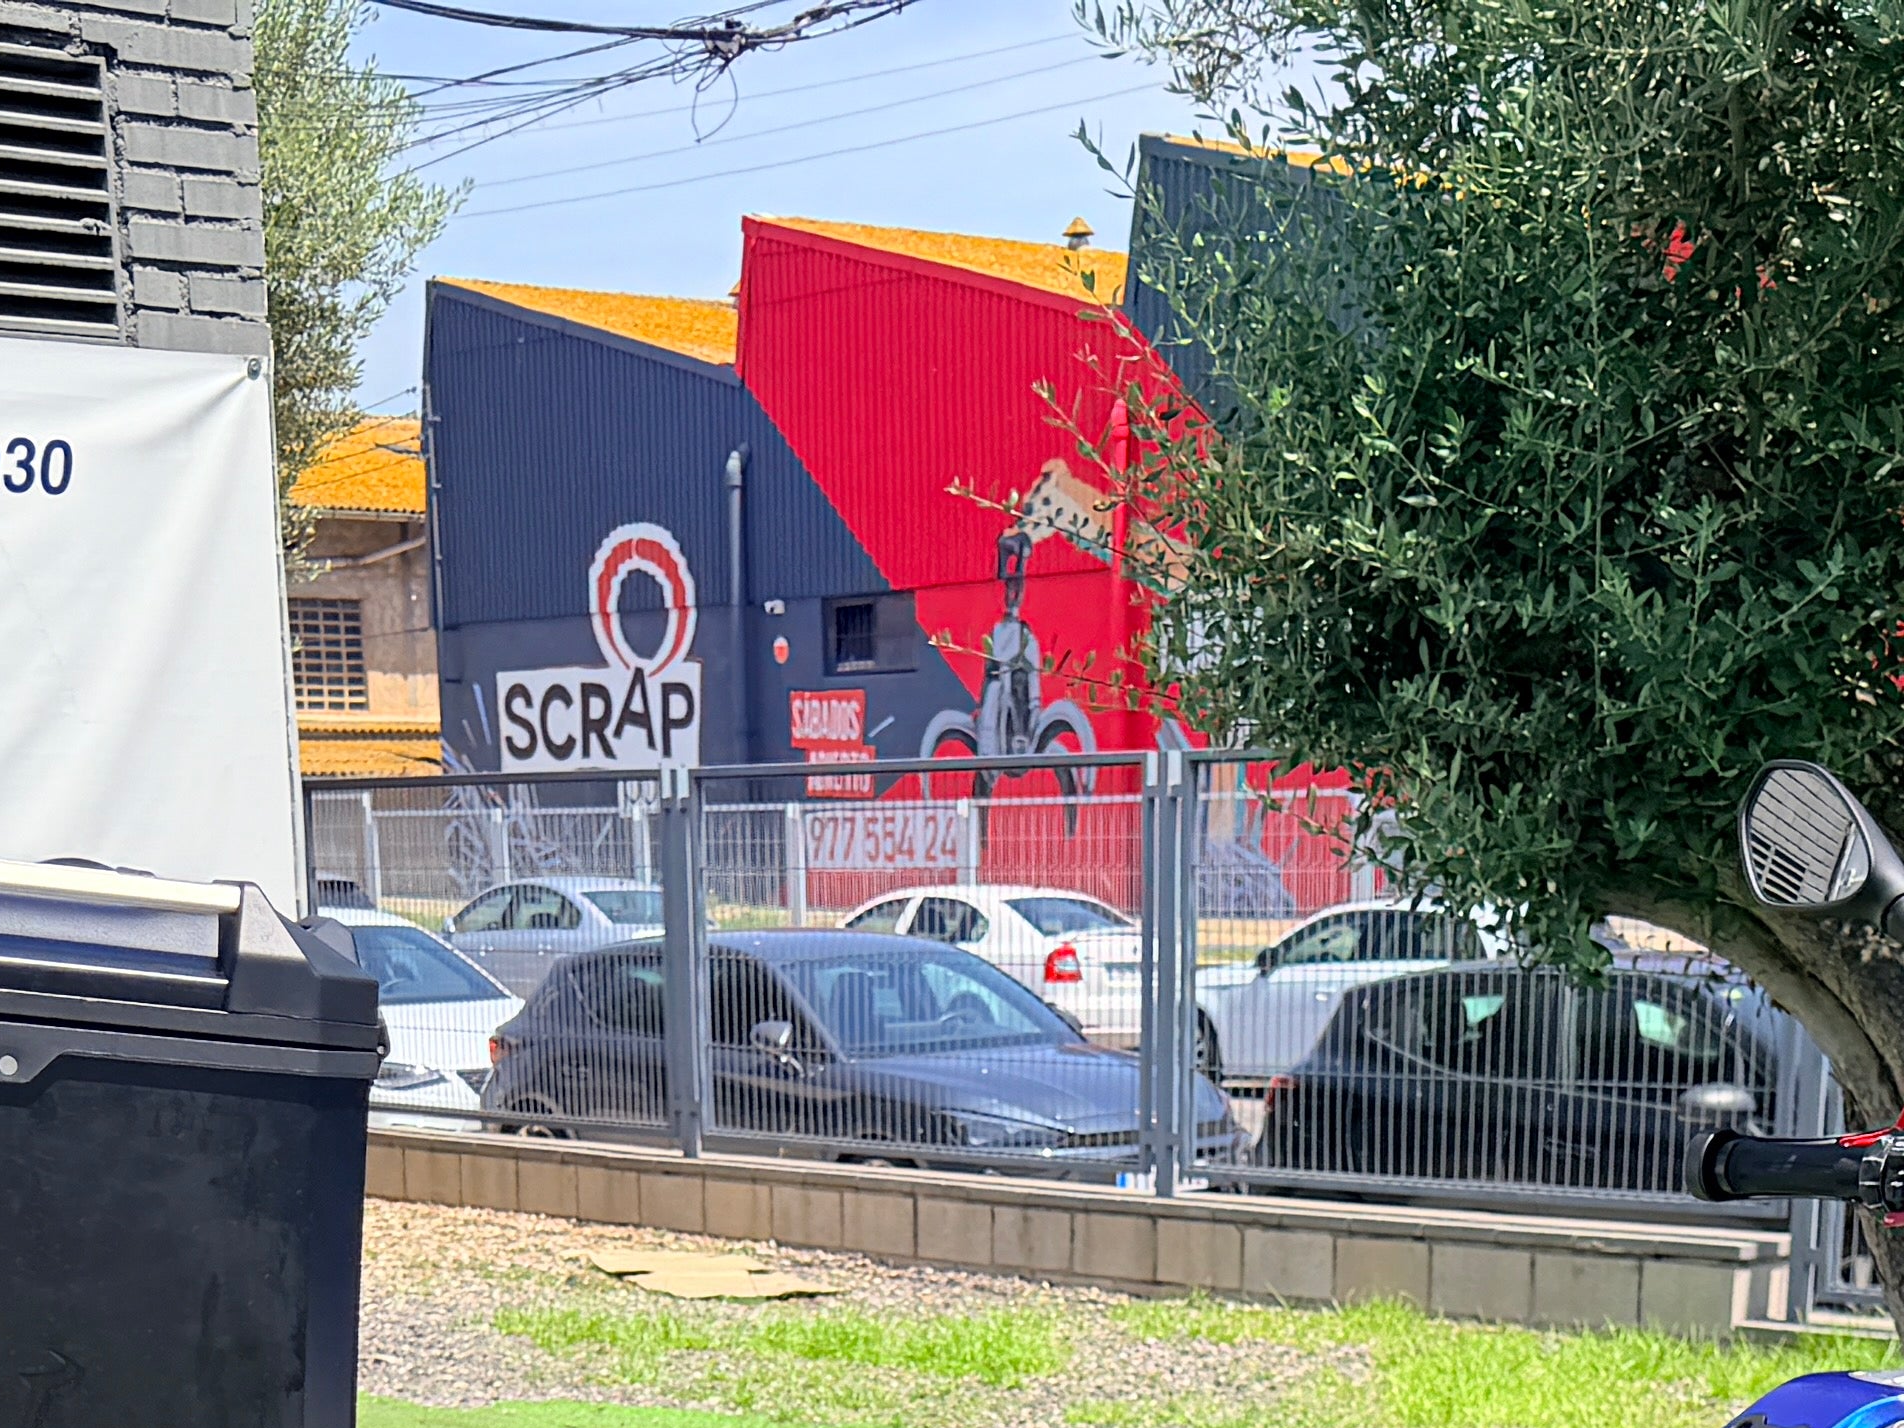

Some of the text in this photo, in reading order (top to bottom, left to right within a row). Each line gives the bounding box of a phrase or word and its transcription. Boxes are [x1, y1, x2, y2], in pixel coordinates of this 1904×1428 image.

[504, 666, 695, 760] SCRAP
[810, 815, 856, 862] 977
[924, 815, 958, 863] 24
